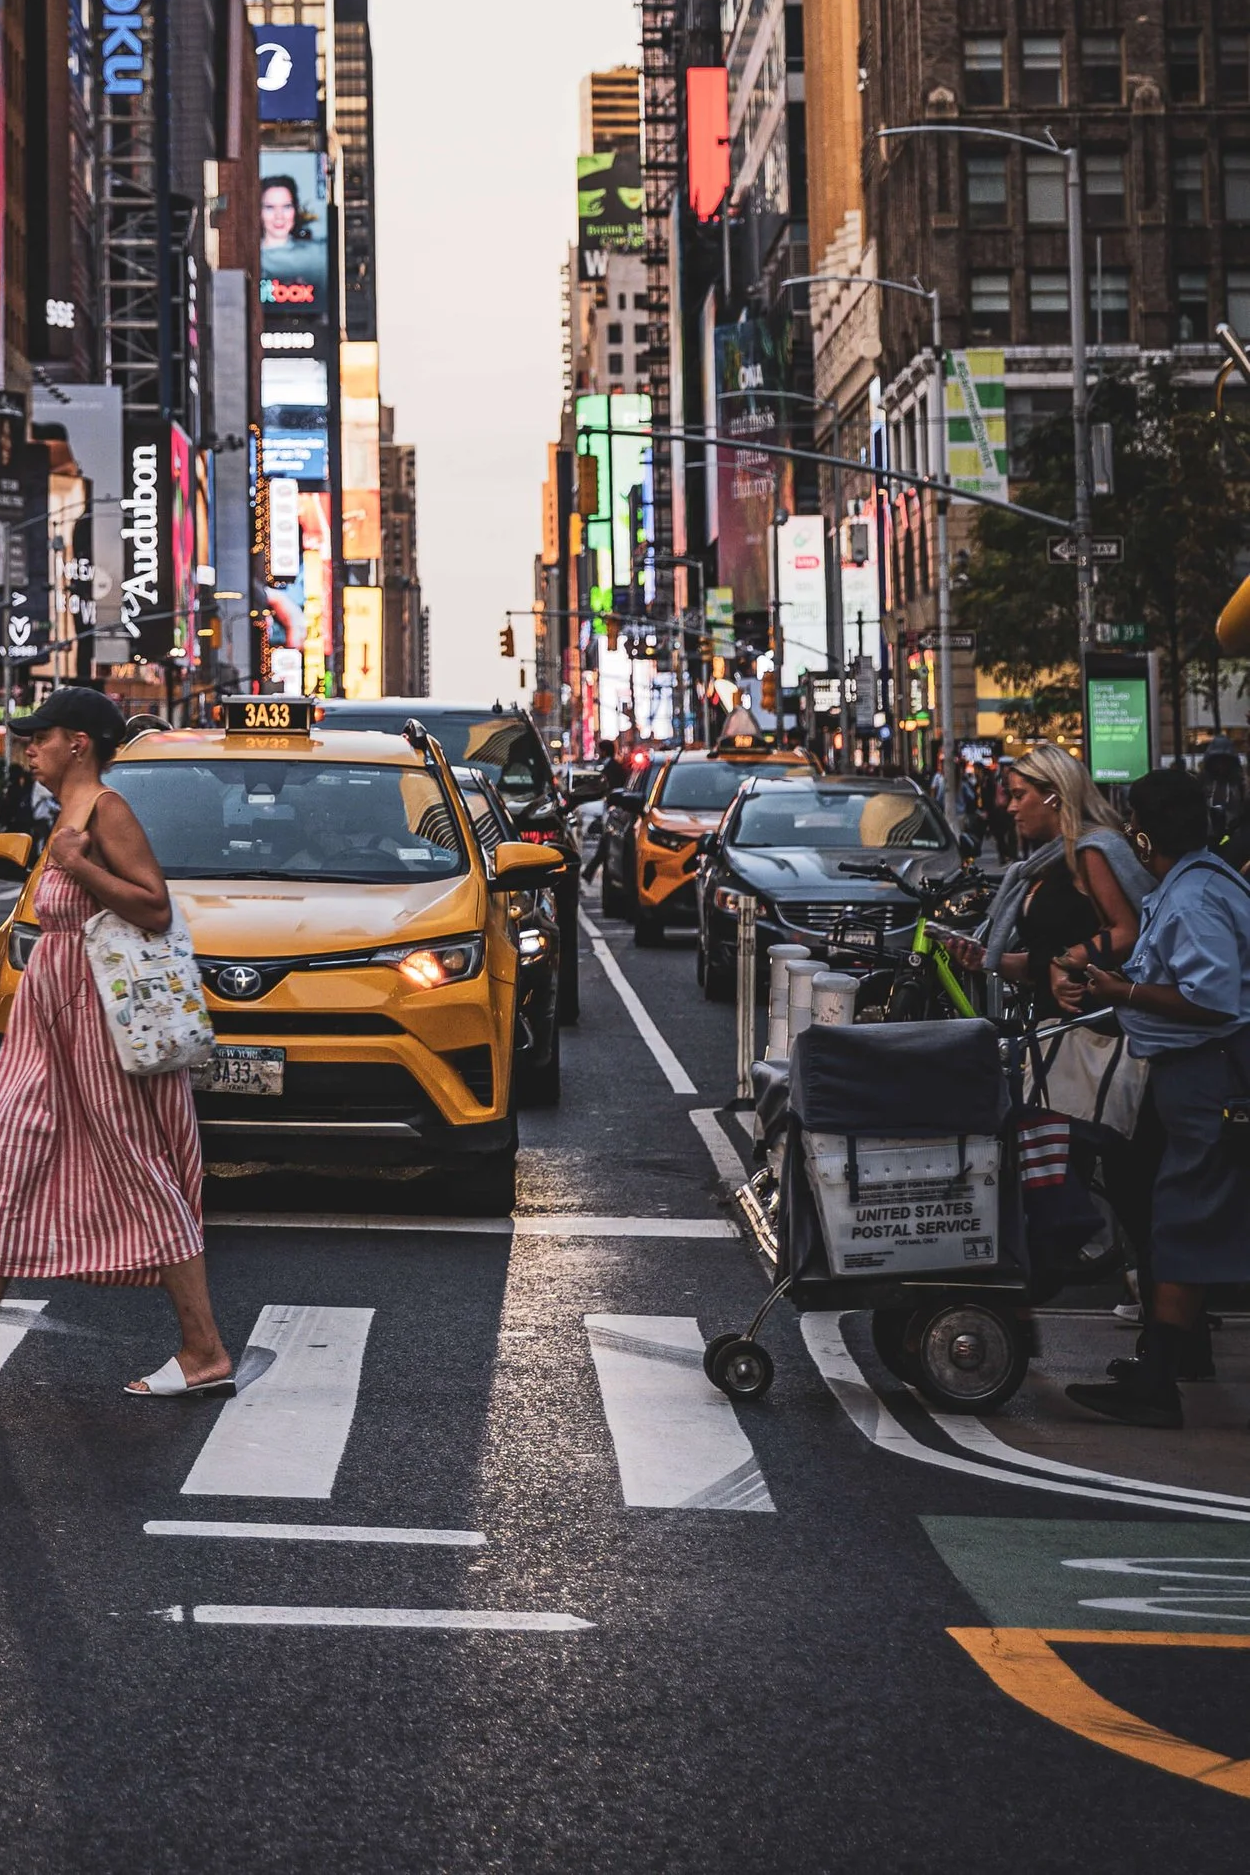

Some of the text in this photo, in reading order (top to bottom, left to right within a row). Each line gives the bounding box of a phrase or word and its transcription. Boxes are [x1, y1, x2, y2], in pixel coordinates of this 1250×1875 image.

[120, 443, 159, 605] Audubon
[244, 703, 290, 727] 3A33
[856, 1202, 973, 1222] UNITED STATES
[852, 1218, 981, 1239] POSTAL SERVICE
